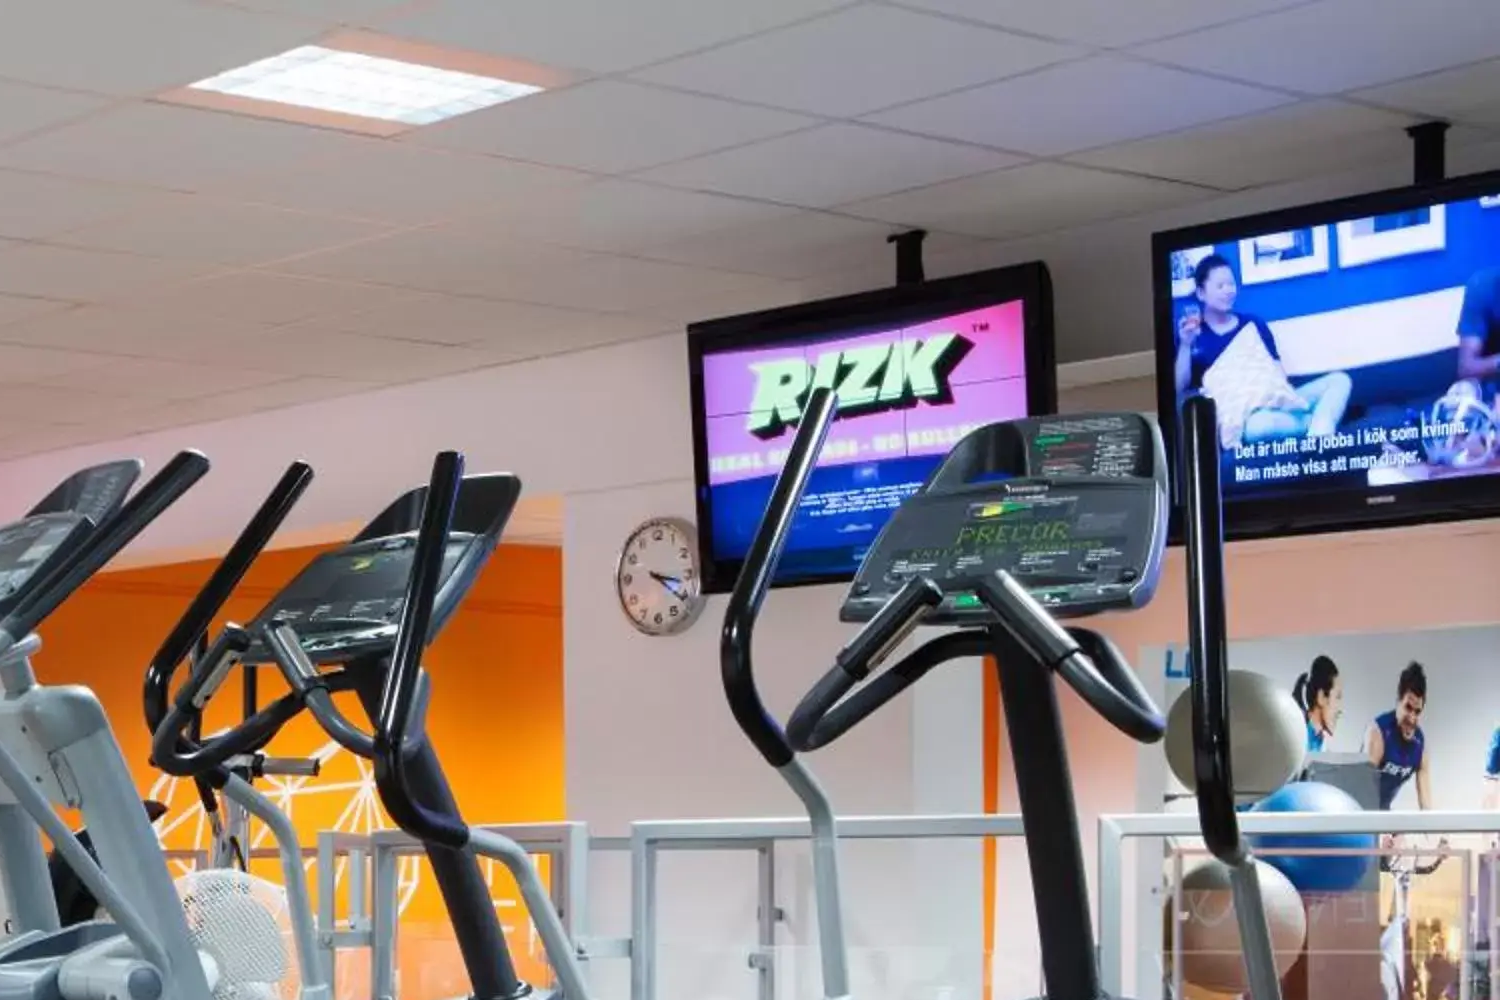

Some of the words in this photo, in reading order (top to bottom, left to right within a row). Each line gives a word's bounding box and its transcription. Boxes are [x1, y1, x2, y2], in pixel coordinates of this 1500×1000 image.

[746, 333, 974, 438] RIZK
[1257, 442, 1270, 457] är
[1272, 437, 1298, 455] tufft
[1300, 435, 1317, 452] att
[1318, 432, 1354, 454] jobba
[1363, 425, 1387, 445] kök
[1390, 427, 1419, 442] som
[1421, 418, 1469, 438] kvinna.
[1235, 465, 1261, 482] Man
[1263, 461, 1300, 480] måste
[1302, 457, 1328, 475] visa
[1330, 455, 1347, 472] att
[1349, 455, 1376, 470] man
[956, 520, 1070, 545] PRECOR
[679, 547, 688, 559] 2
[669, 605, 679, 617] 5
